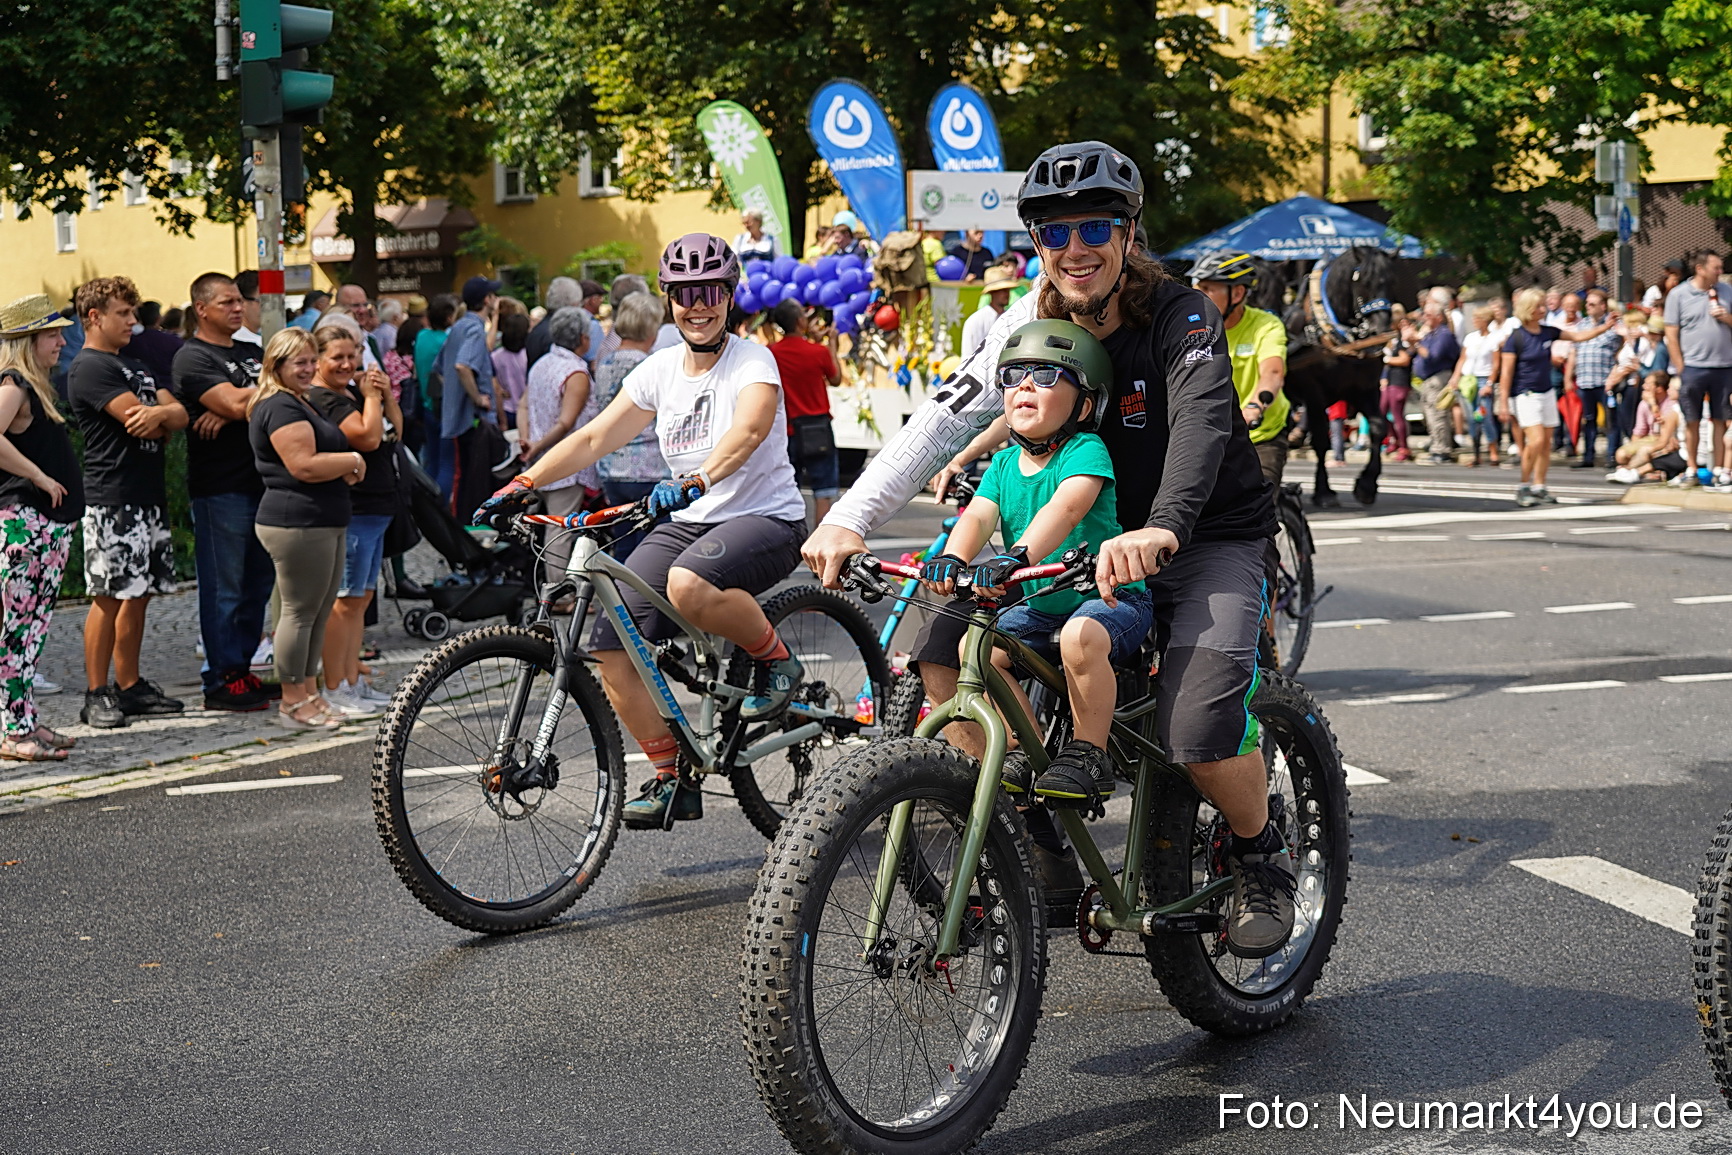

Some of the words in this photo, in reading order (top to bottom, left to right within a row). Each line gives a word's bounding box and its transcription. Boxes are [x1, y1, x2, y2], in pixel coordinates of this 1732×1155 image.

[1060, 354, 1083, 369] uvex
[1120, 391, 1143, 406] JURA
[614, 604, 690, 727] NUKEPROOF
